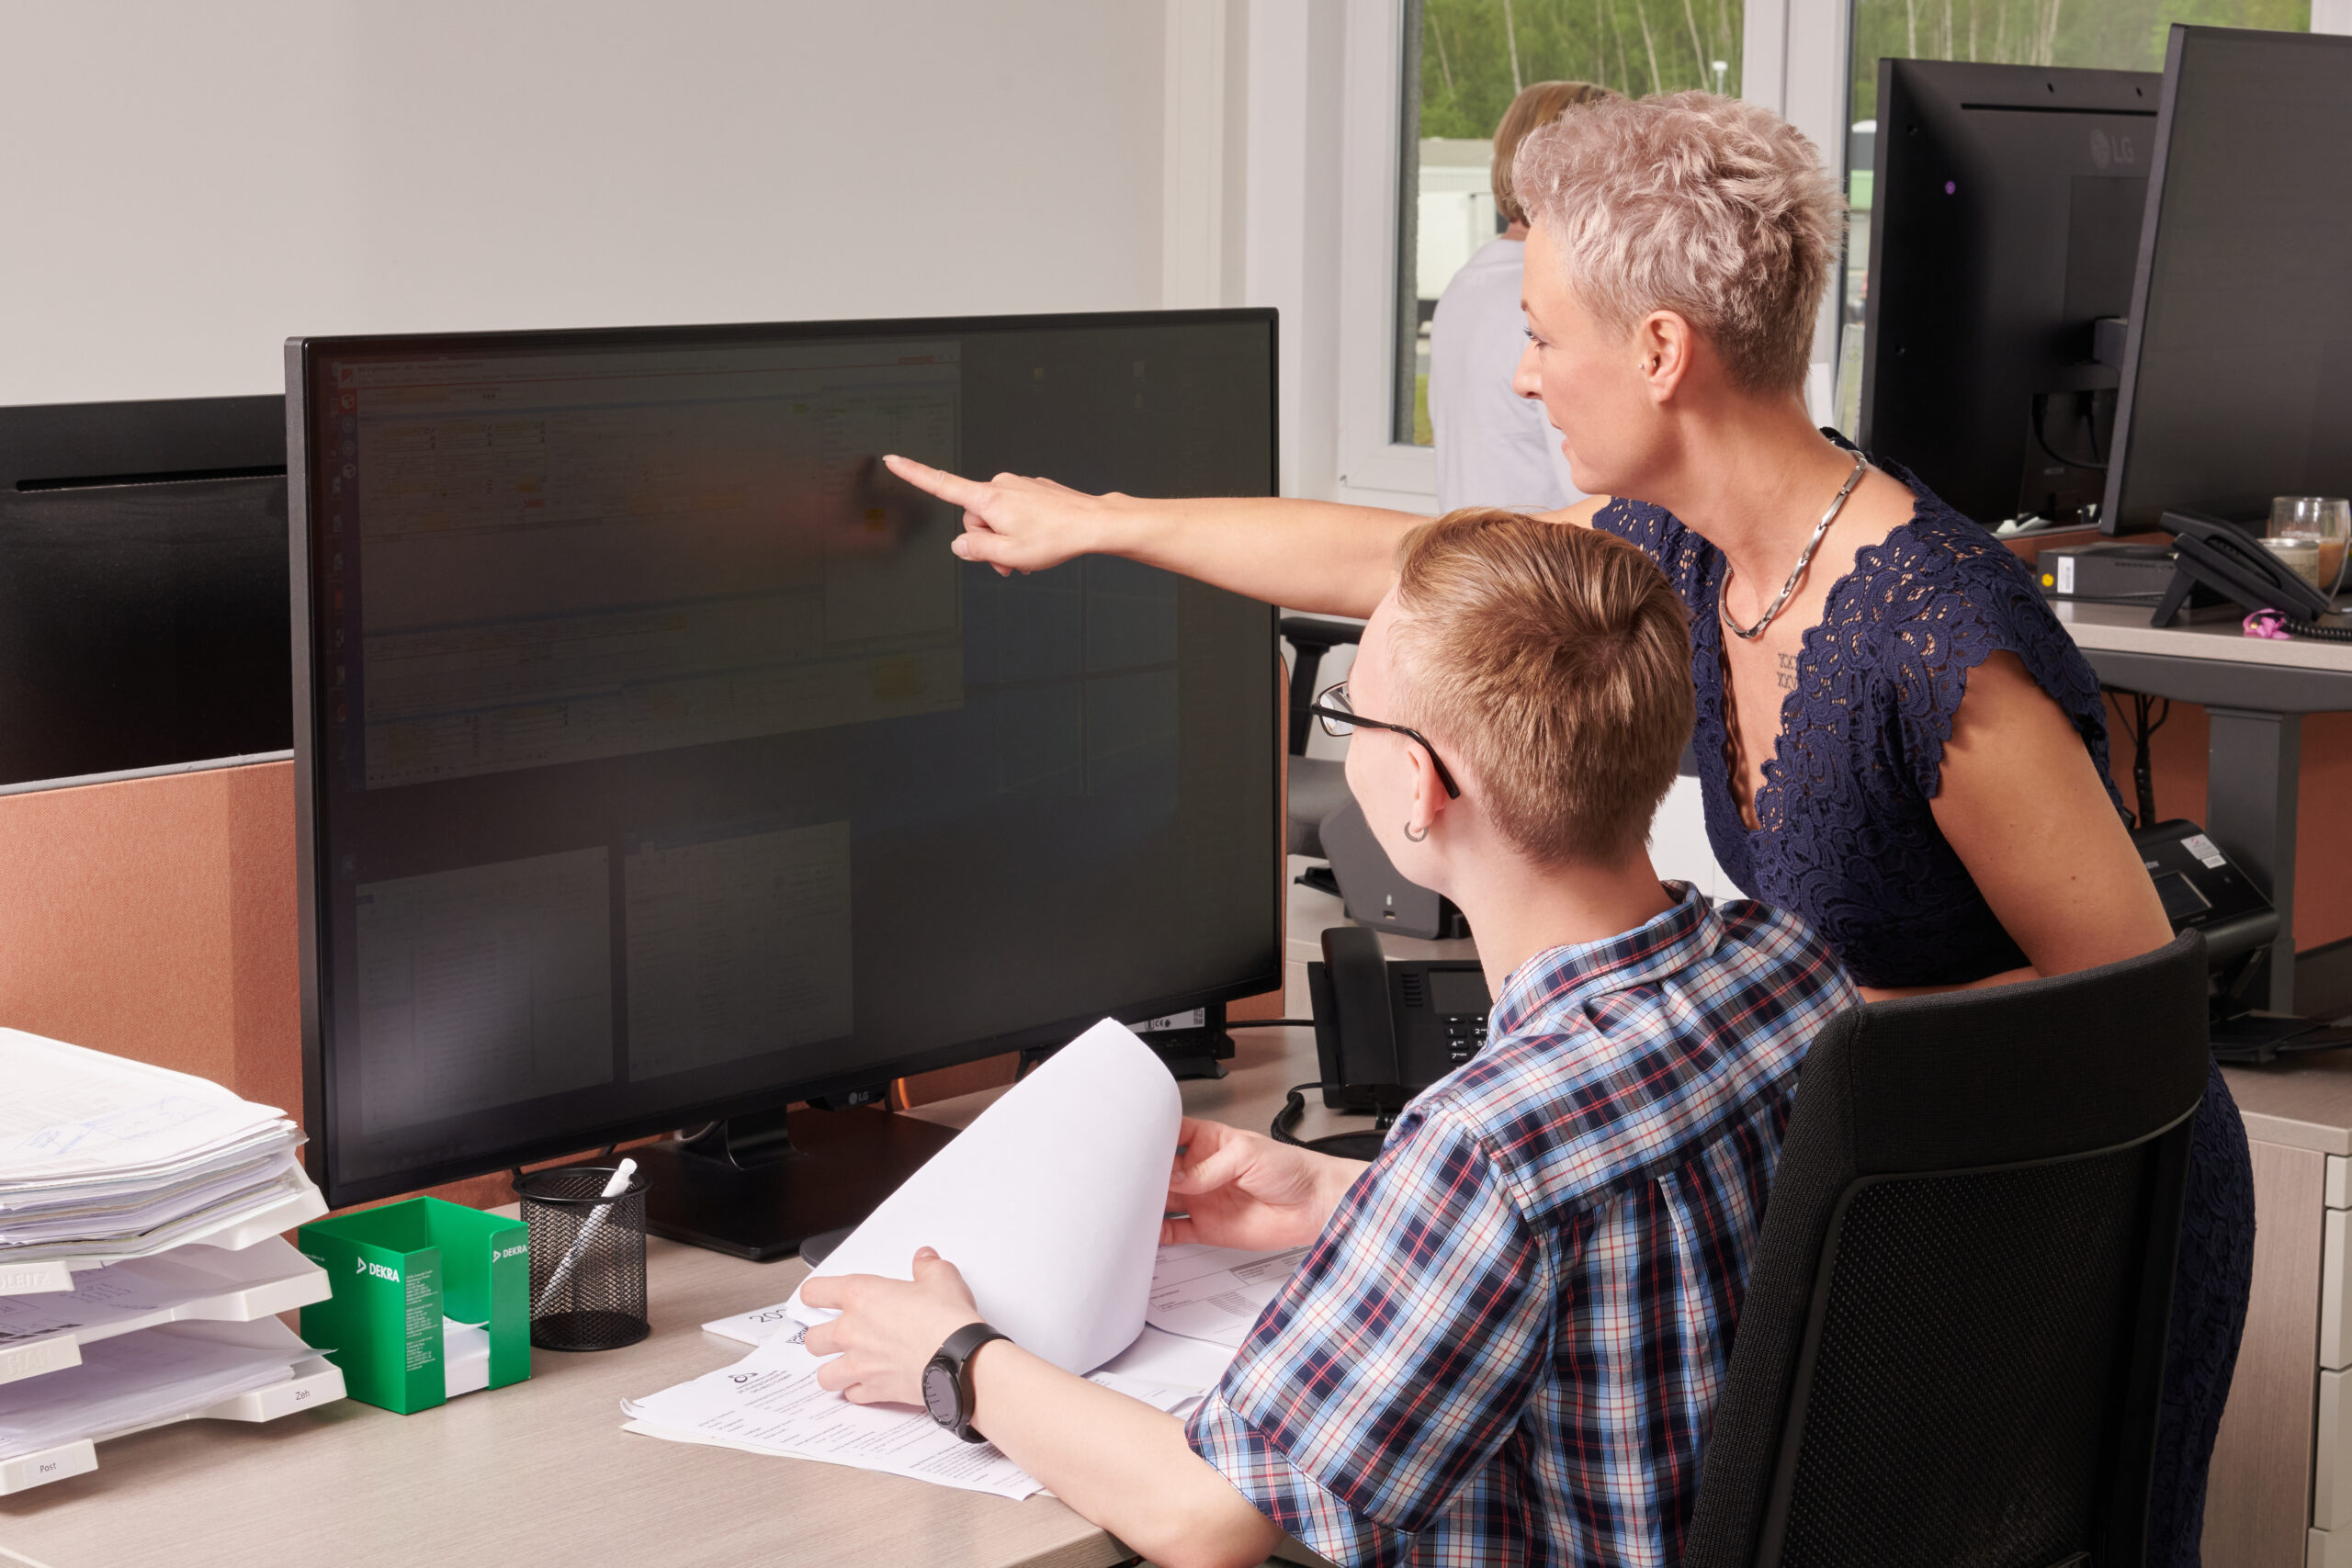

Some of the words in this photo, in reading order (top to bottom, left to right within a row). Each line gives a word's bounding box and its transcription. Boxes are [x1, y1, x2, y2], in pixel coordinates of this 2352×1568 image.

[858, 1090, 869, 1102] LG
[503, 1244, 527, 1258] DEKRA
[368, 1262, 401, 1283] DEKRA
[295, 1389, 311, 1401] Zeh
[40, 1462, 57, 1473] Post
